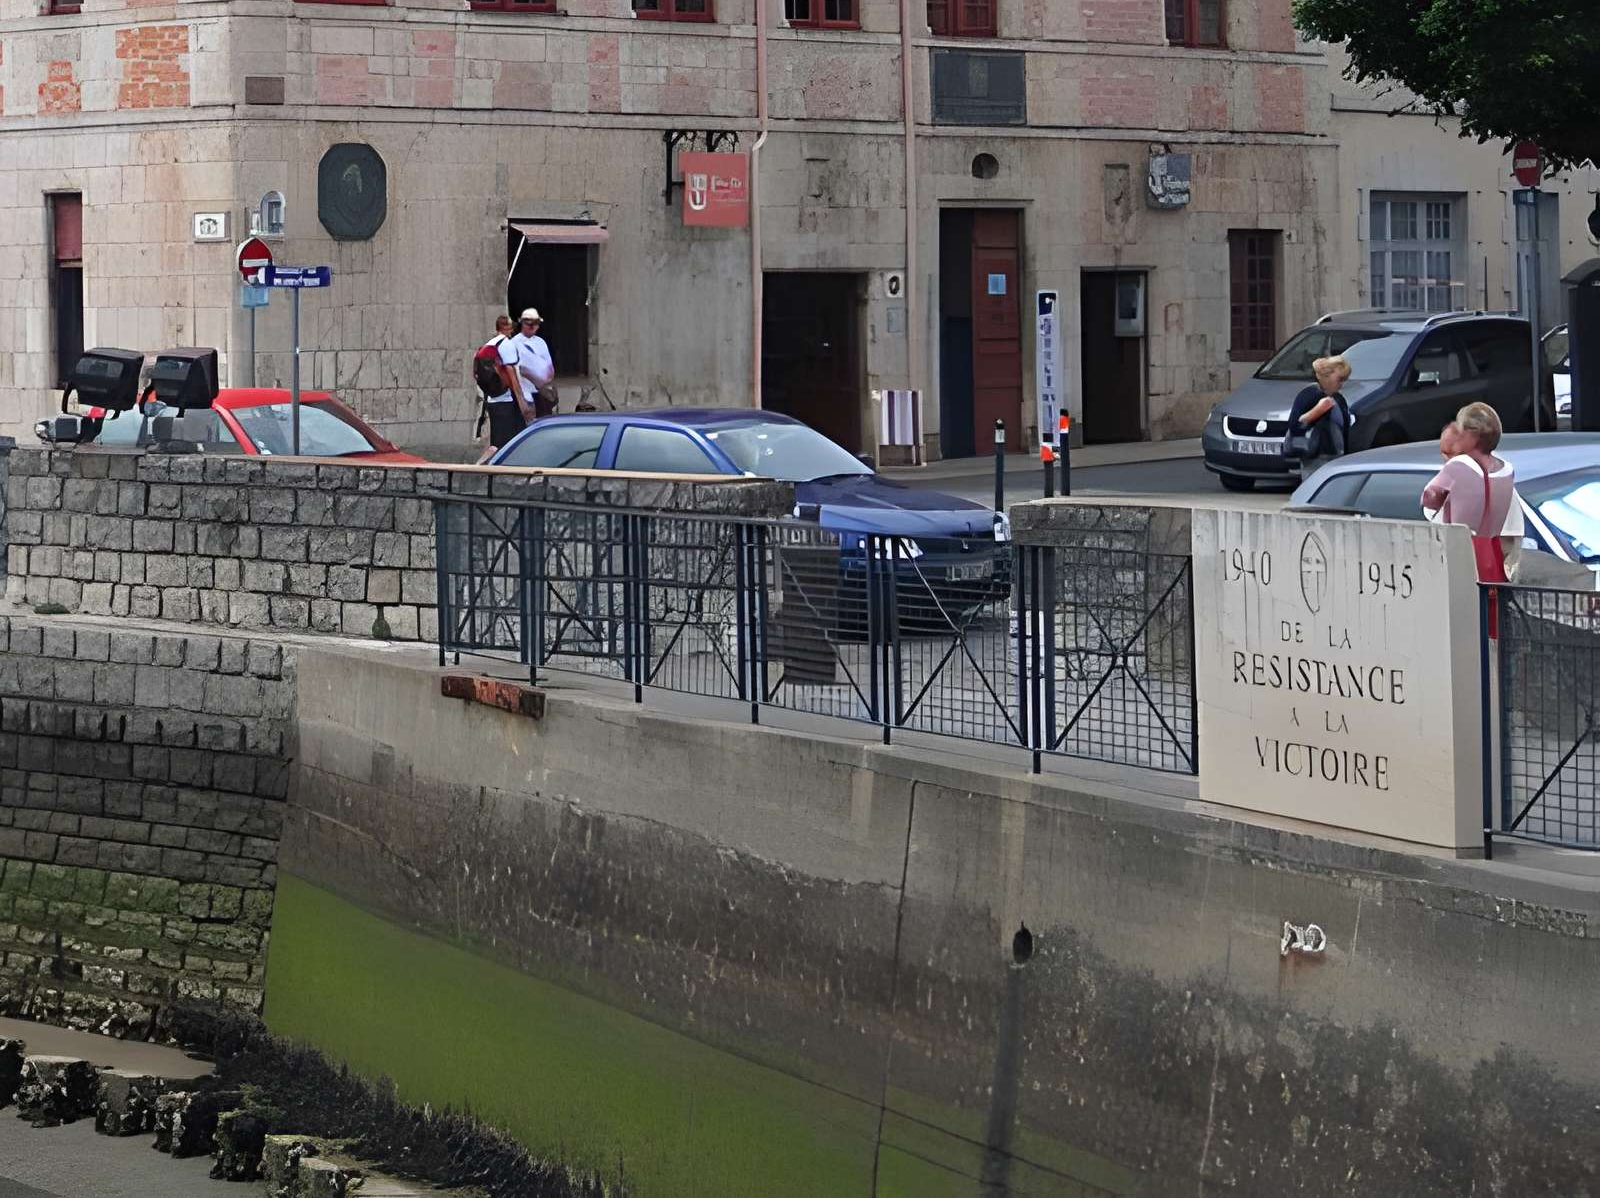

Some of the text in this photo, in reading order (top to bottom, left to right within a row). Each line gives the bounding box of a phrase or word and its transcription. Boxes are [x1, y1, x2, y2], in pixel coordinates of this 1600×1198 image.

[1220, 548, 1413, 599] 1940 1945
[1280, 619, 1352, 649] DE LA
[1232, 650, 1406, 704] RESISTANCE
[1324, 709, 1350, 734] LA
[1255, 735, 1389, 791] VICTOIRE
